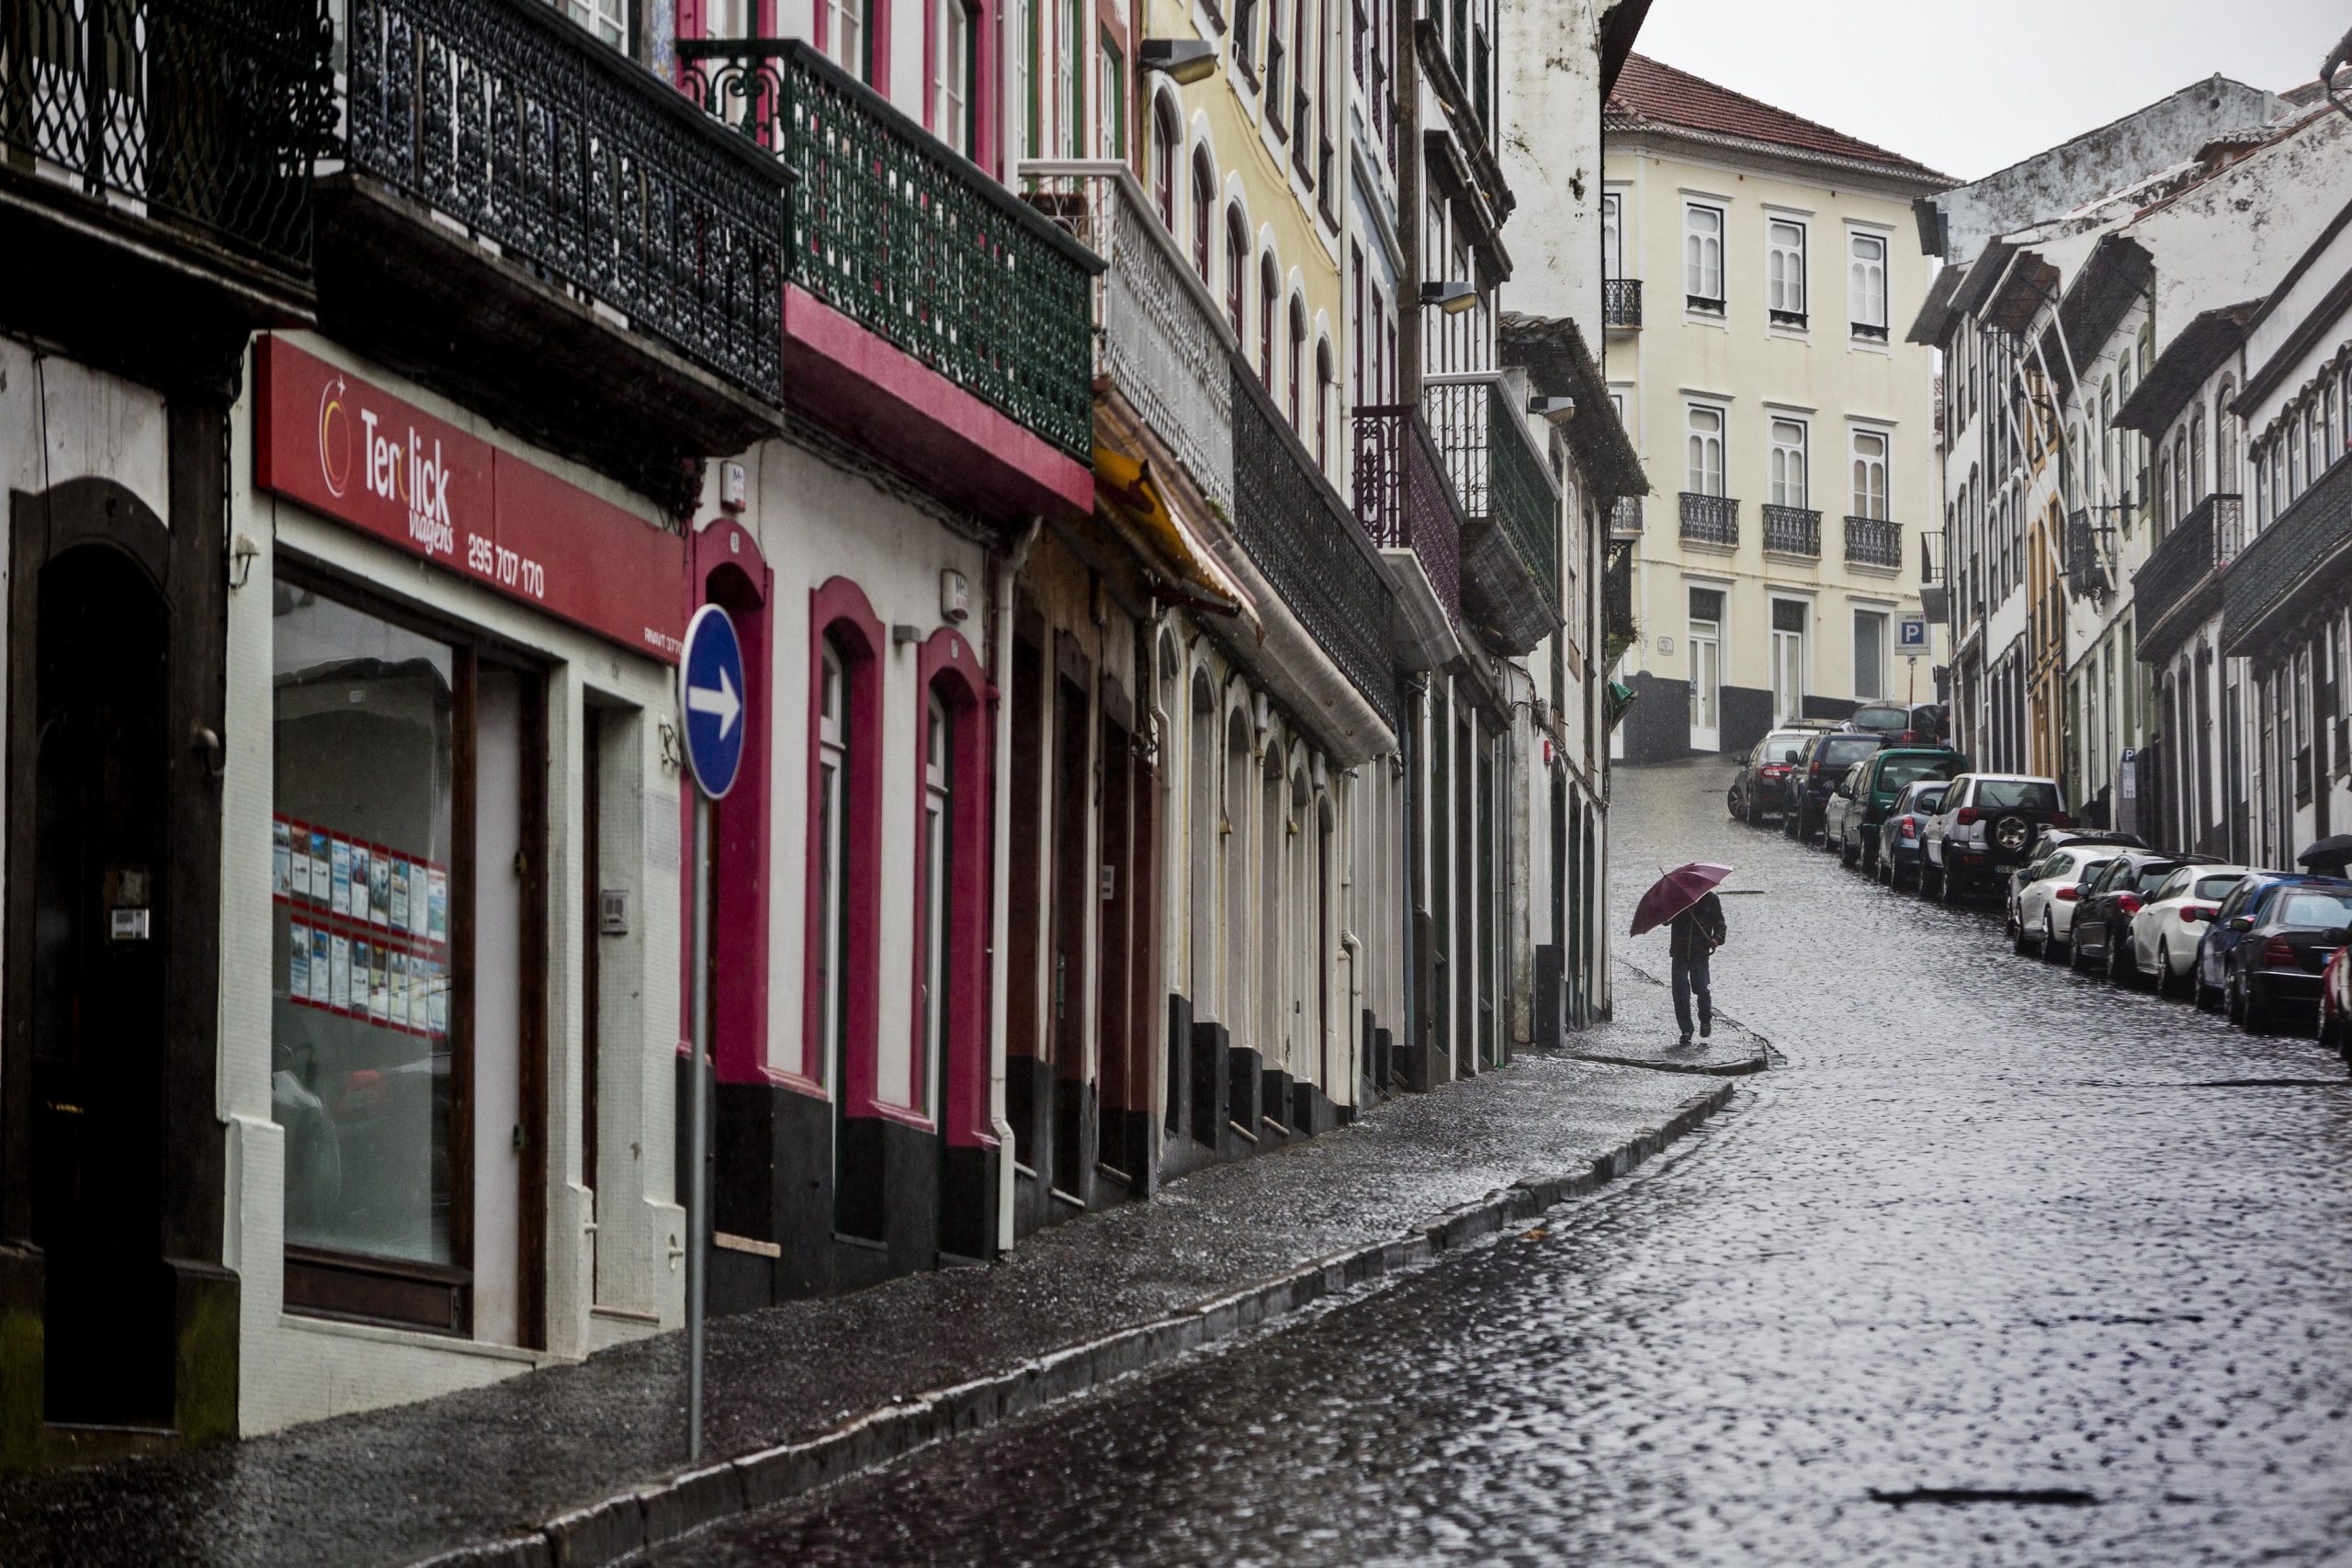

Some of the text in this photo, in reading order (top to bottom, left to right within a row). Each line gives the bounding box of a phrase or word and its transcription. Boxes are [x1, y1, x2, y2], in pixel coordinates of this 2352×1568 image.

[409, 509, 453, 555] viagens
[468, 532, 545, 599] 295 707 170
[1905, 625, 1920, 642] P
[2125, 749, 2134, 761] P
